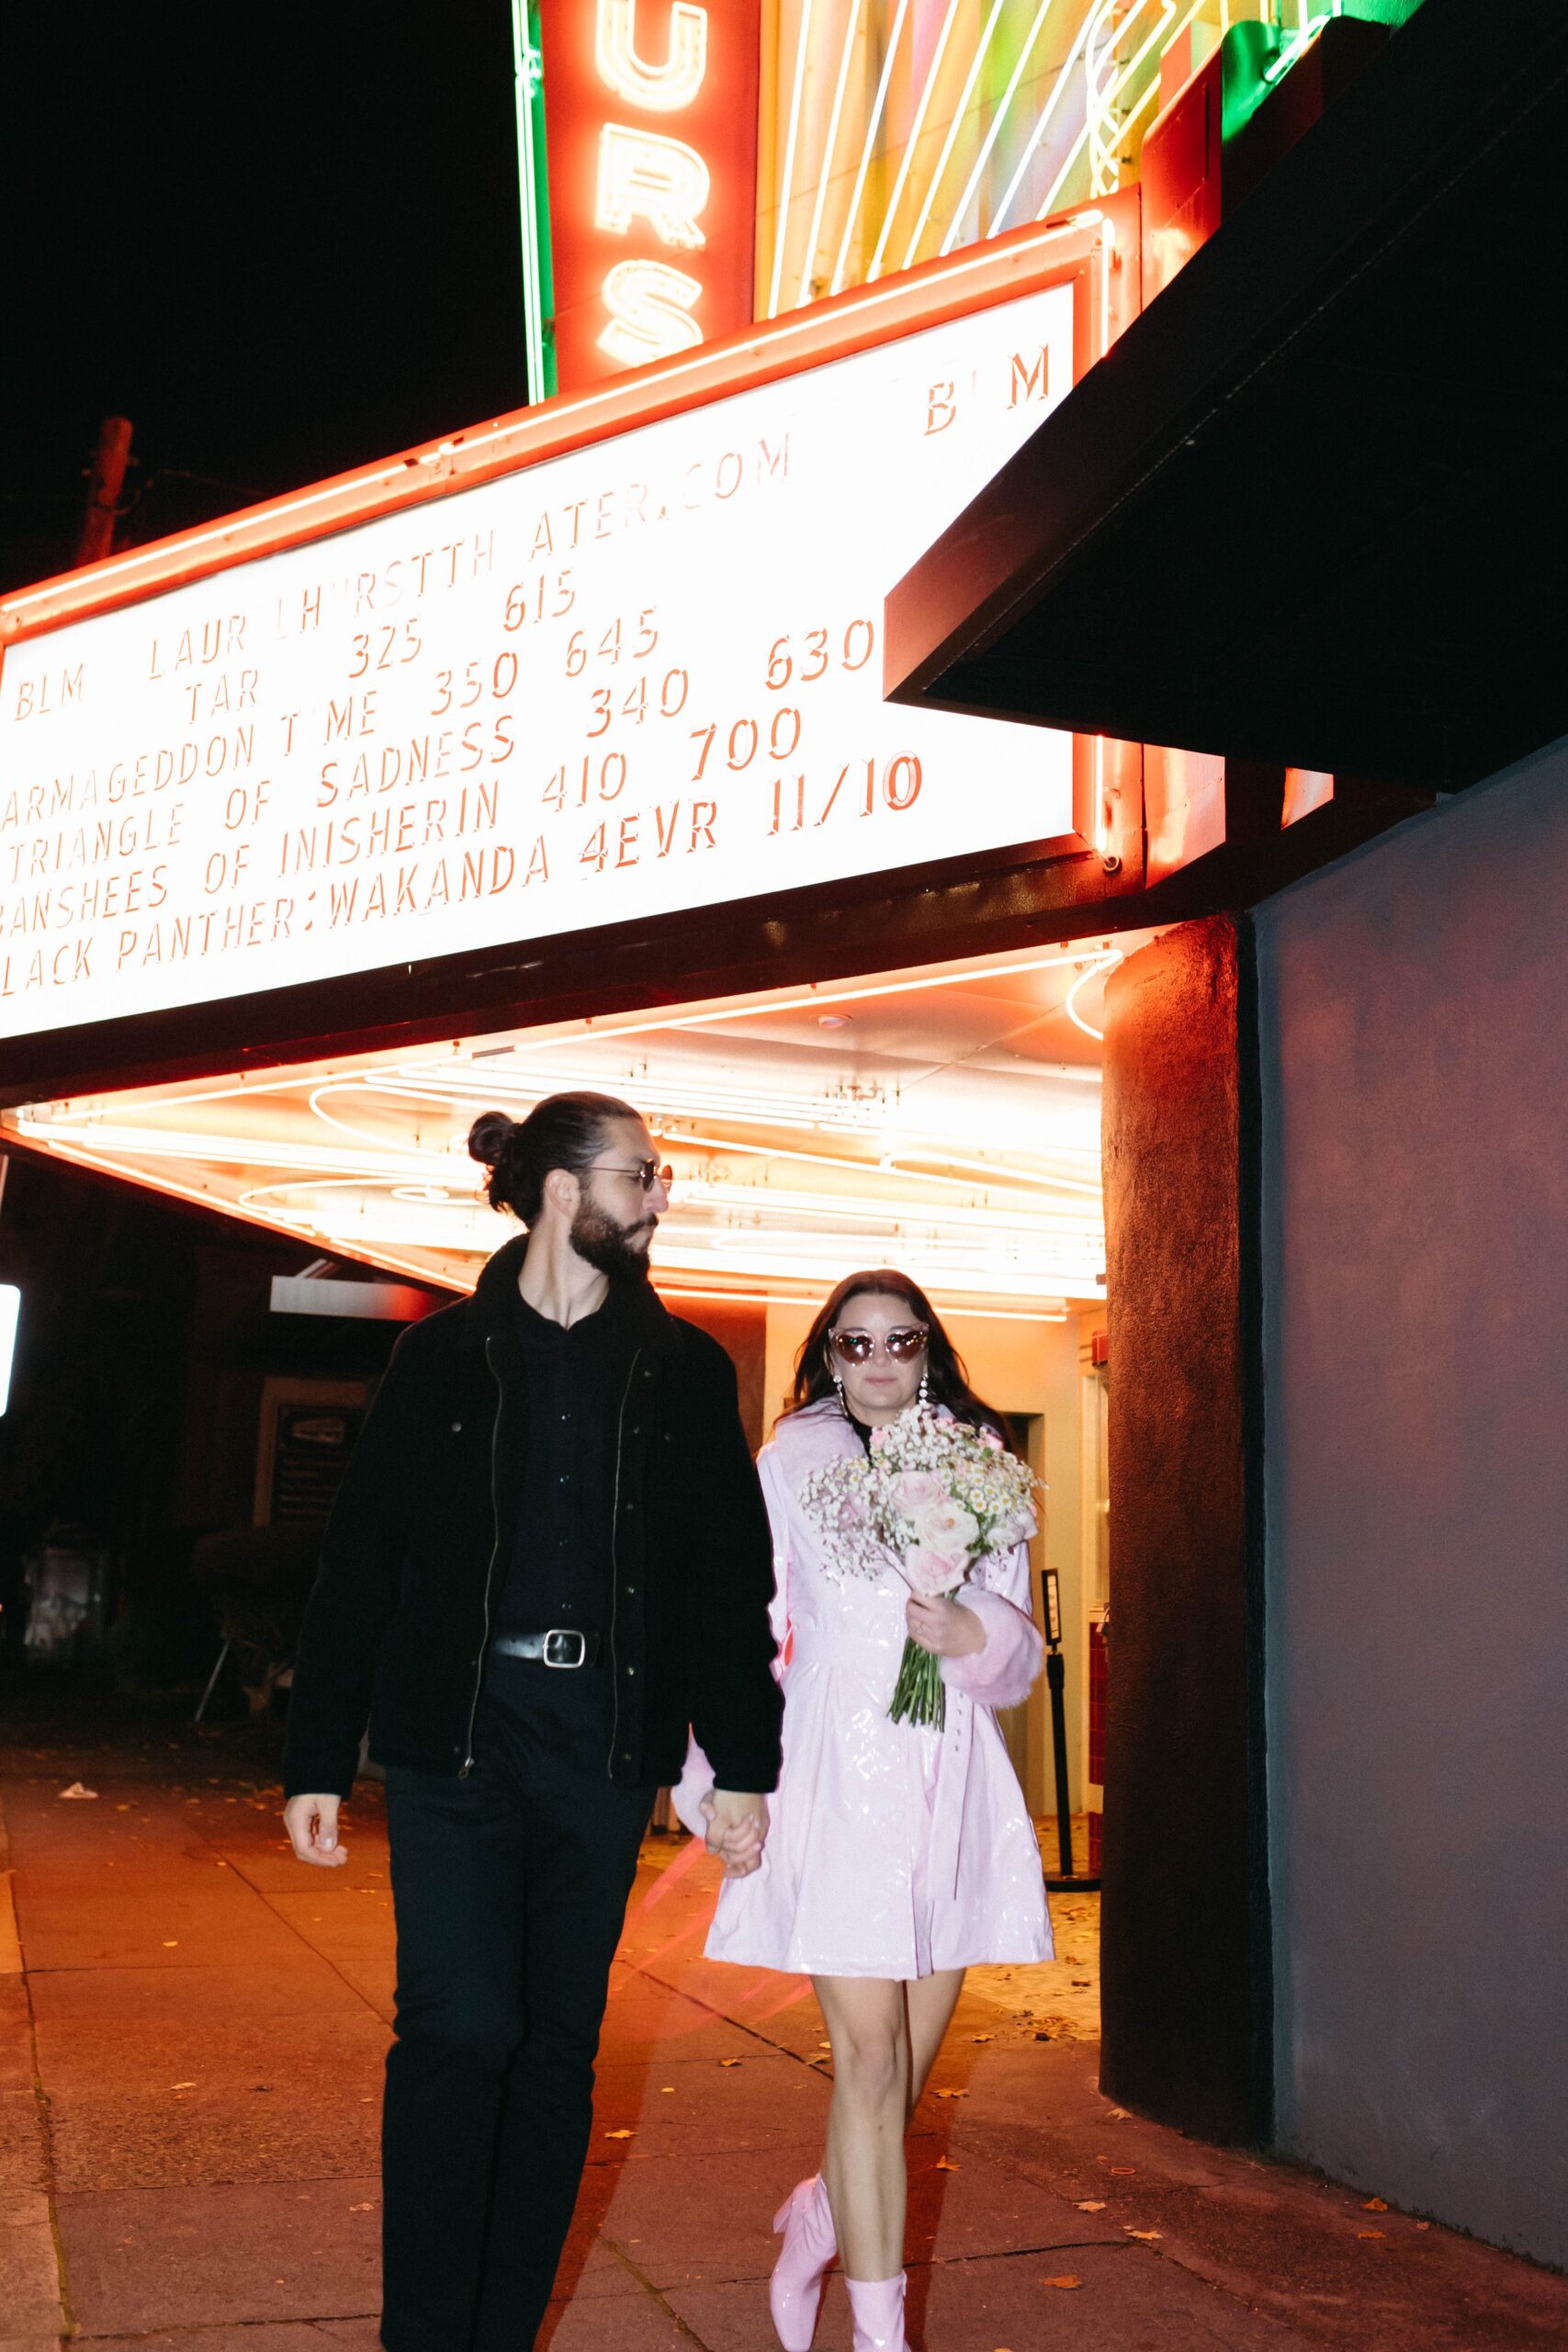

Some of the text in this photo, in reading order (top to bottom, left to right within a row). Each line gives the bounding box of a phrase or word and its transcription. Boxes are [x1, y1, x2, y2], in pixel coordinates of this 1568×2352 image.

[0, 605, 659, 831] ARMAGEDDON TME 350 645
[14, 662, 85, 722] BLM
[185, 566, 576, 725] TAR 325 615
[0, 707, 802, 940] ANSHEES OF INISHERIN 410 700
[8, 618, 874, 884] TRIANGLE OF SADNESS 340 630
[579, 797, 718, 874] 4EVR
[762, 749, 924, 837] 11/10
